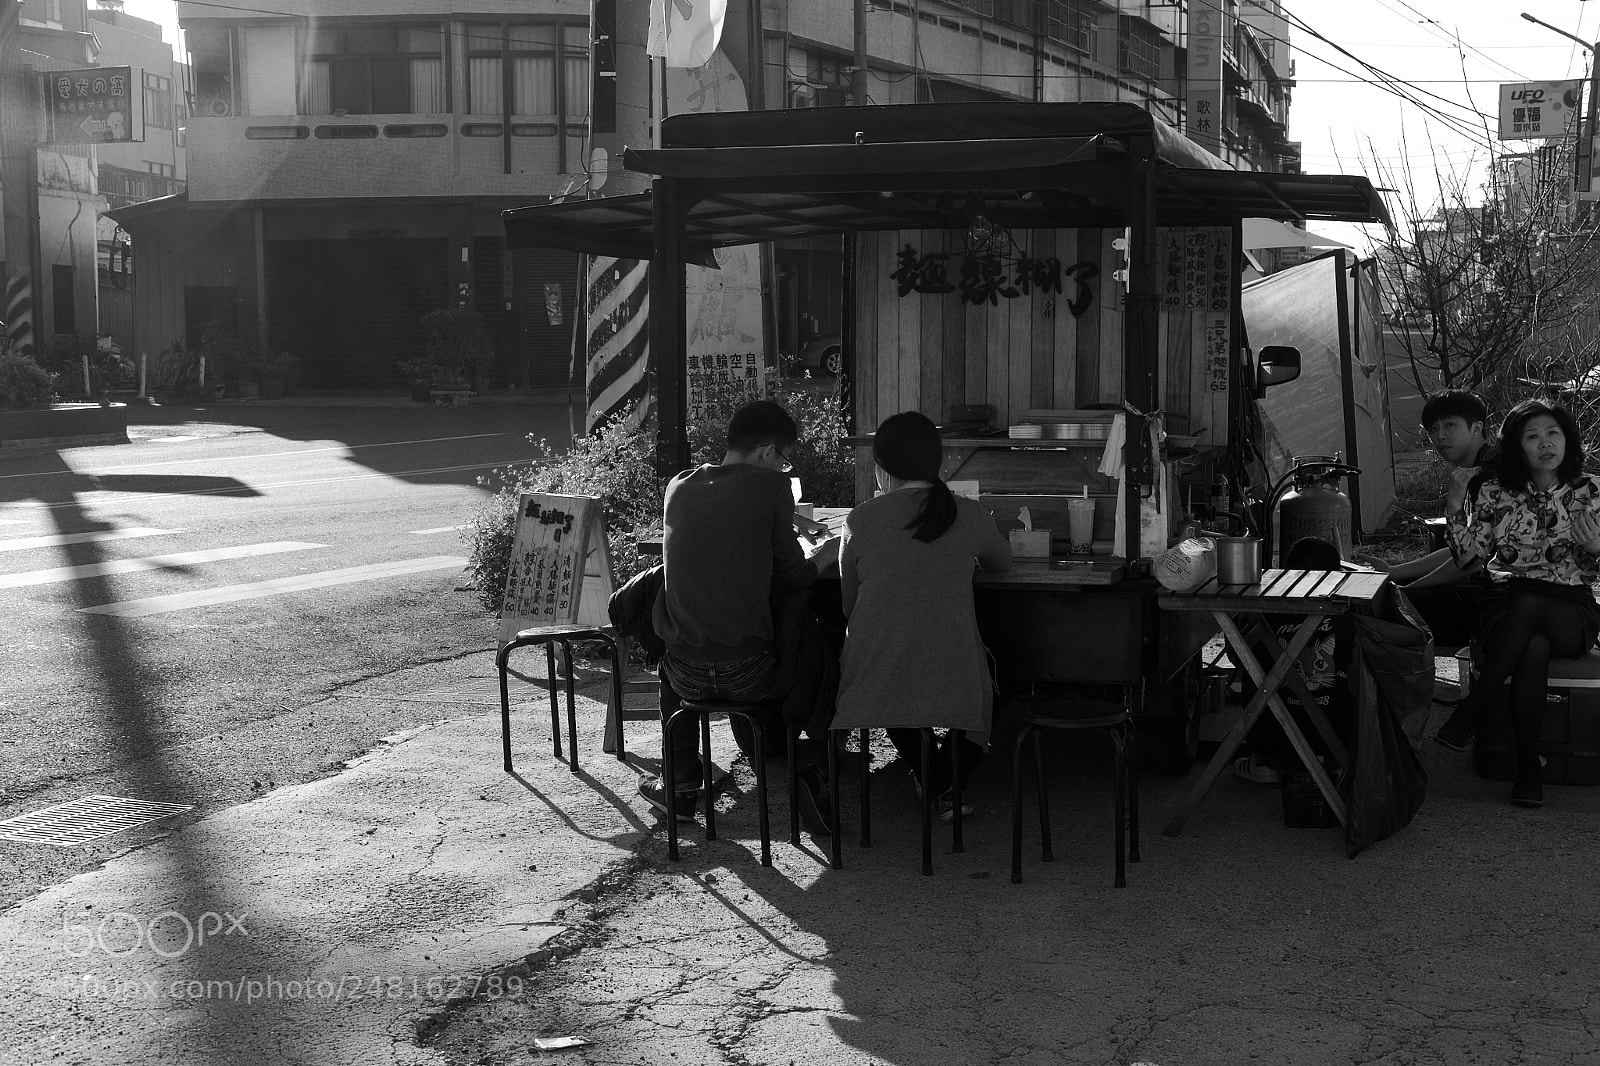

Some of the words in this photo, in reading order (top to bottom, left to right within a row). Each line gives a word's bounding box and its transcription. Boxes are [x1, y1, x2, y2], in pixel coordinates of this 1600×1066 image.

[58, 75, 124, 98] 愛犬の窩
[1511, 89, 1545, 101] UFO
[1197, 100, 1211, 132] 歌林
[1513, 107, 1541, 122] 優福
[890, 244, 1098, 320] 麵線糊了
[1210, 381, 1227, 391] 65
[505, 602, 514, 612] 60
[559, 600, 568, 609] 30
[530, 607, 539, 615] 40
[544, 607, 553, 615] 40
